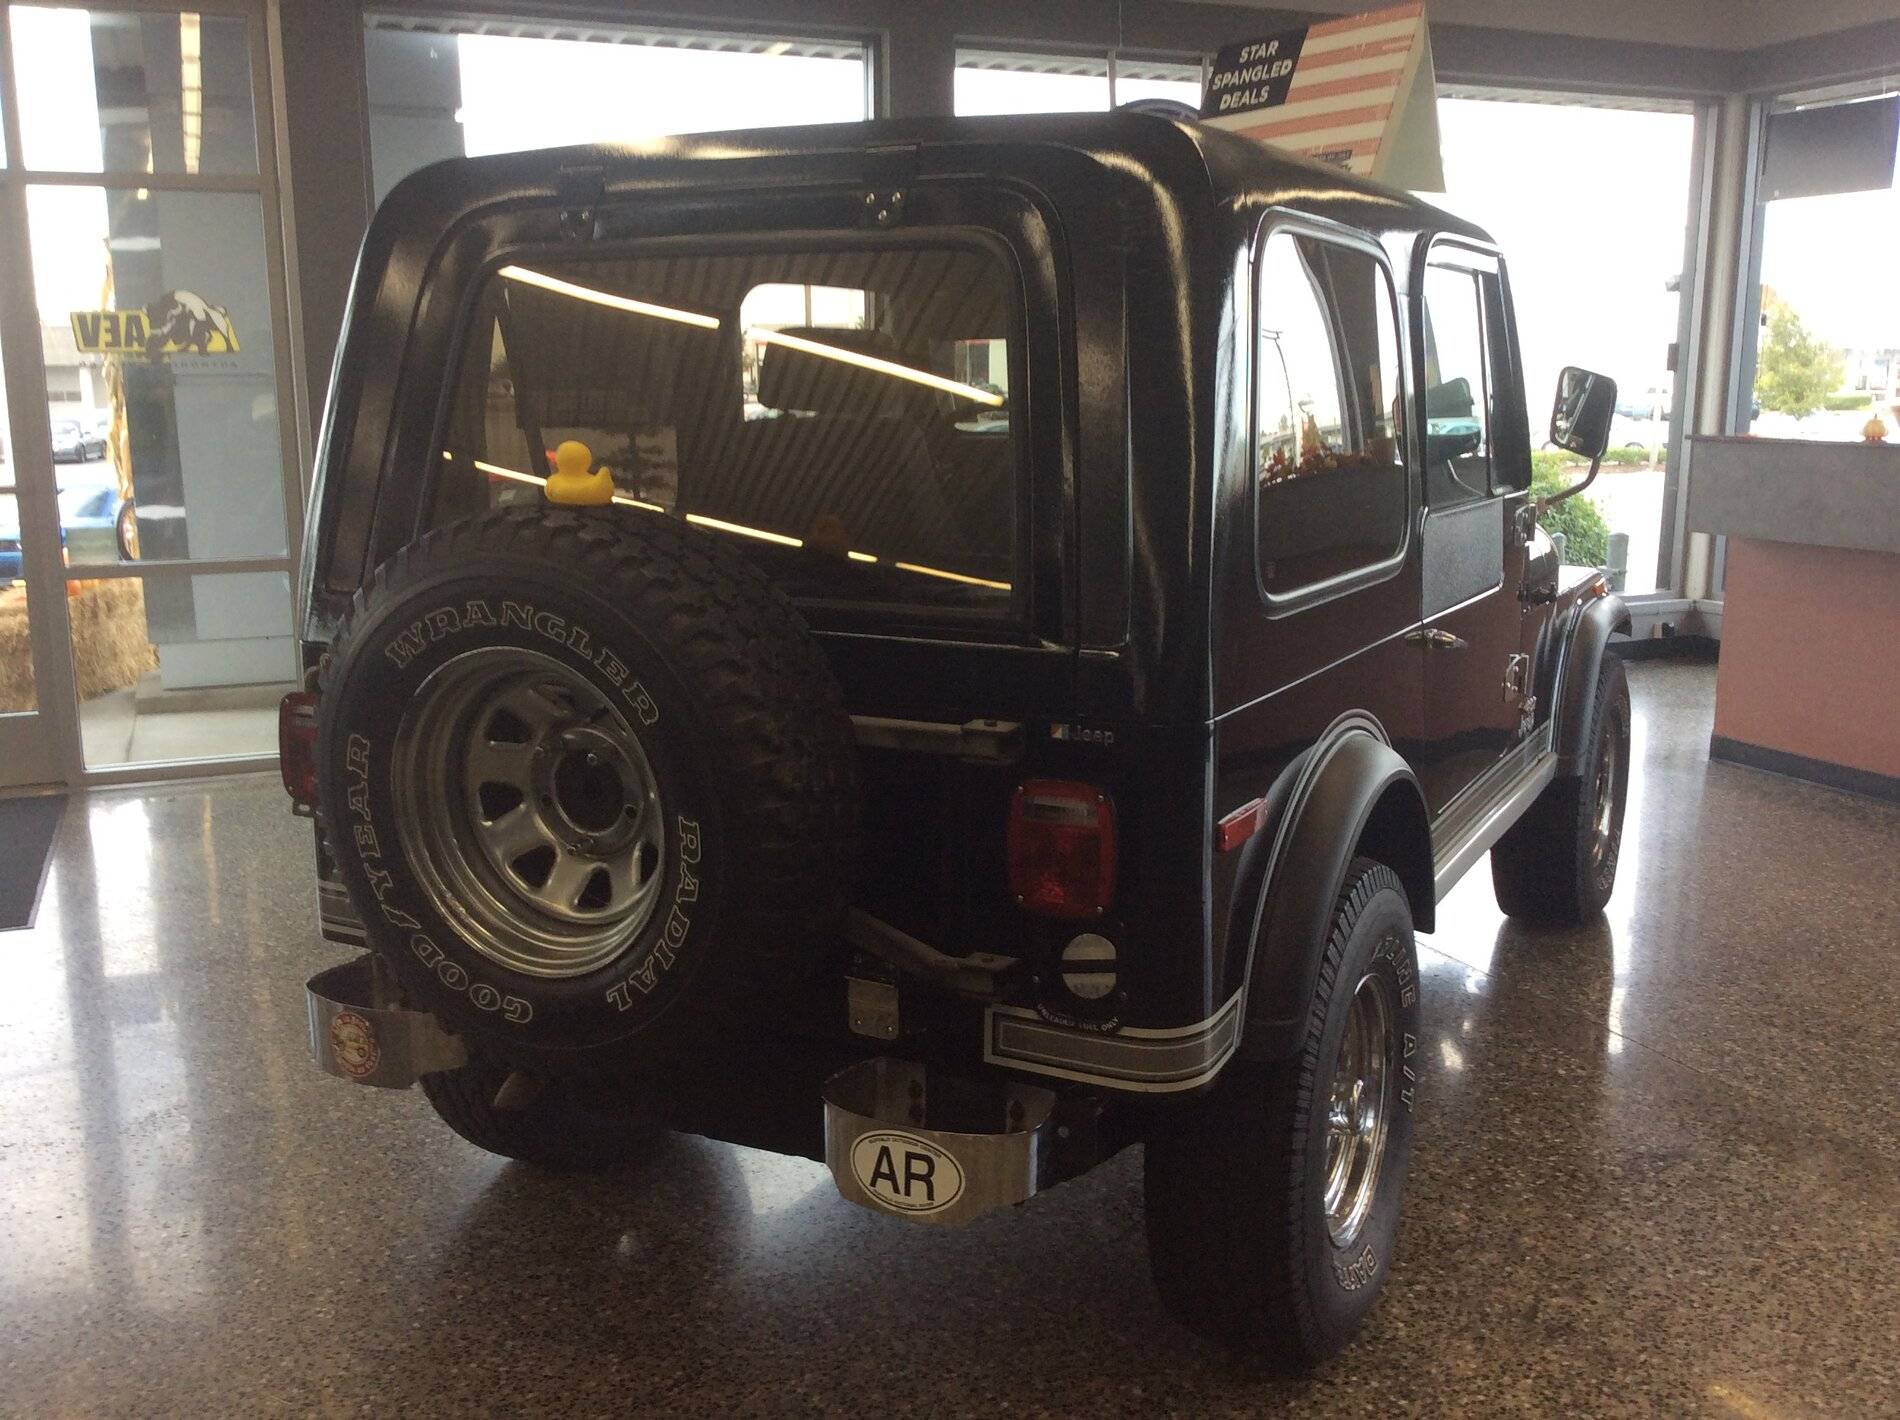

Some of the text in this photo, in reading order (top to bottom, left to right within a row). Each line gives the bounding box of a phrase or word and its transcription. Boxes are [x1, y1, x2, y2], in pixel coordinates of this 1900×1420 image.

[1212, 59, 1293, 90] SPANGLED
[1239, 40, 1279, 64] STAR
[1218, 85, 1270, 111] DEALS
[385, 600, 659, 726] WRANGLER
[346, 734, 533, 1024] GOODYEAR
[606, 816, 701, 1011] RADIAL
[869, 1145, 936, 1202] AR
